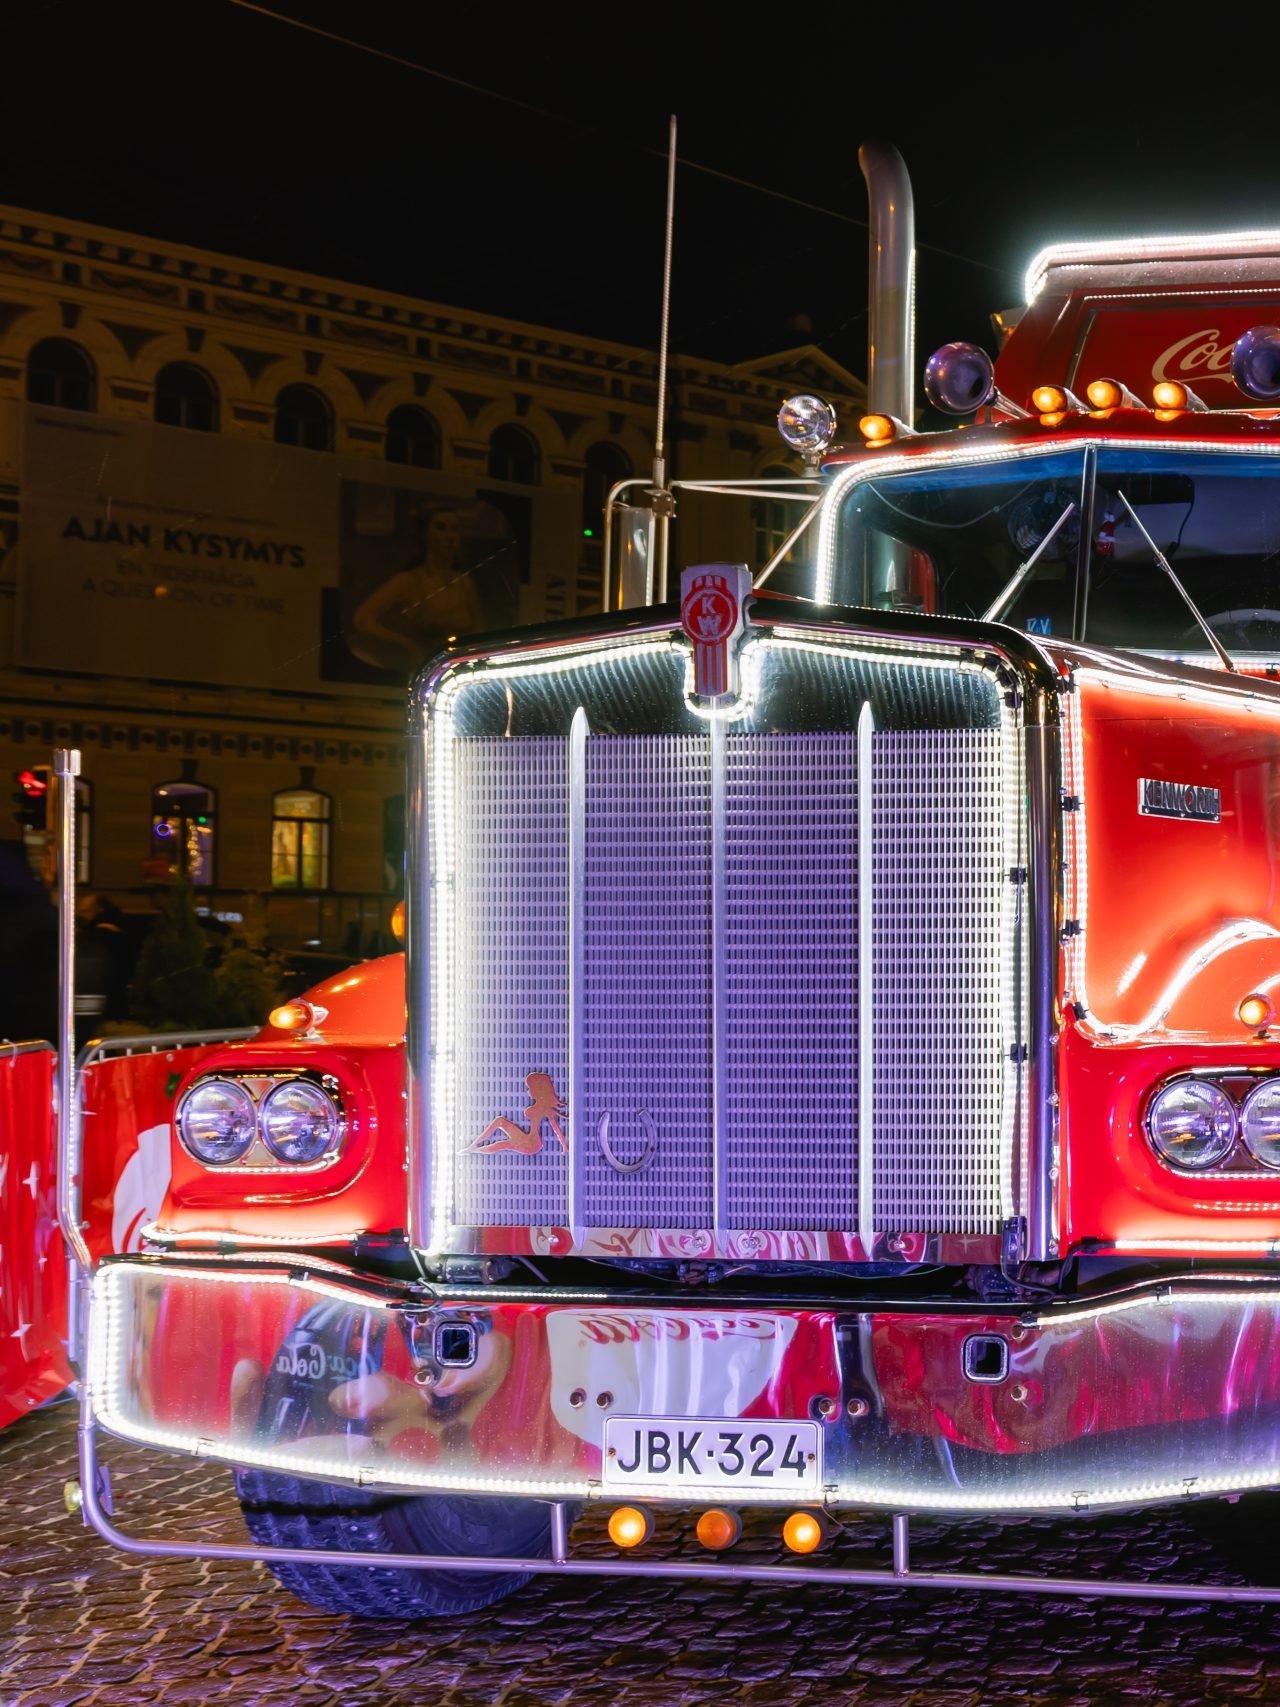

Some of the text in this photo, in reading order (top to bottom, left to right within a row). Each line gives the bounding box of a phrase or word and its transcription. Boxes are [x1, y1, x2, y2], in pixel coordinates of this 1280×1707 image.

[62, 516, 305, 568] AJAN KYSYMYS
[83, 577, 95, 592] A
[209, 591, 234, 609] OF
[1143, 779, 1219, 815] KENWORTH
[617, 1430, 807, 1478] JBK-324
